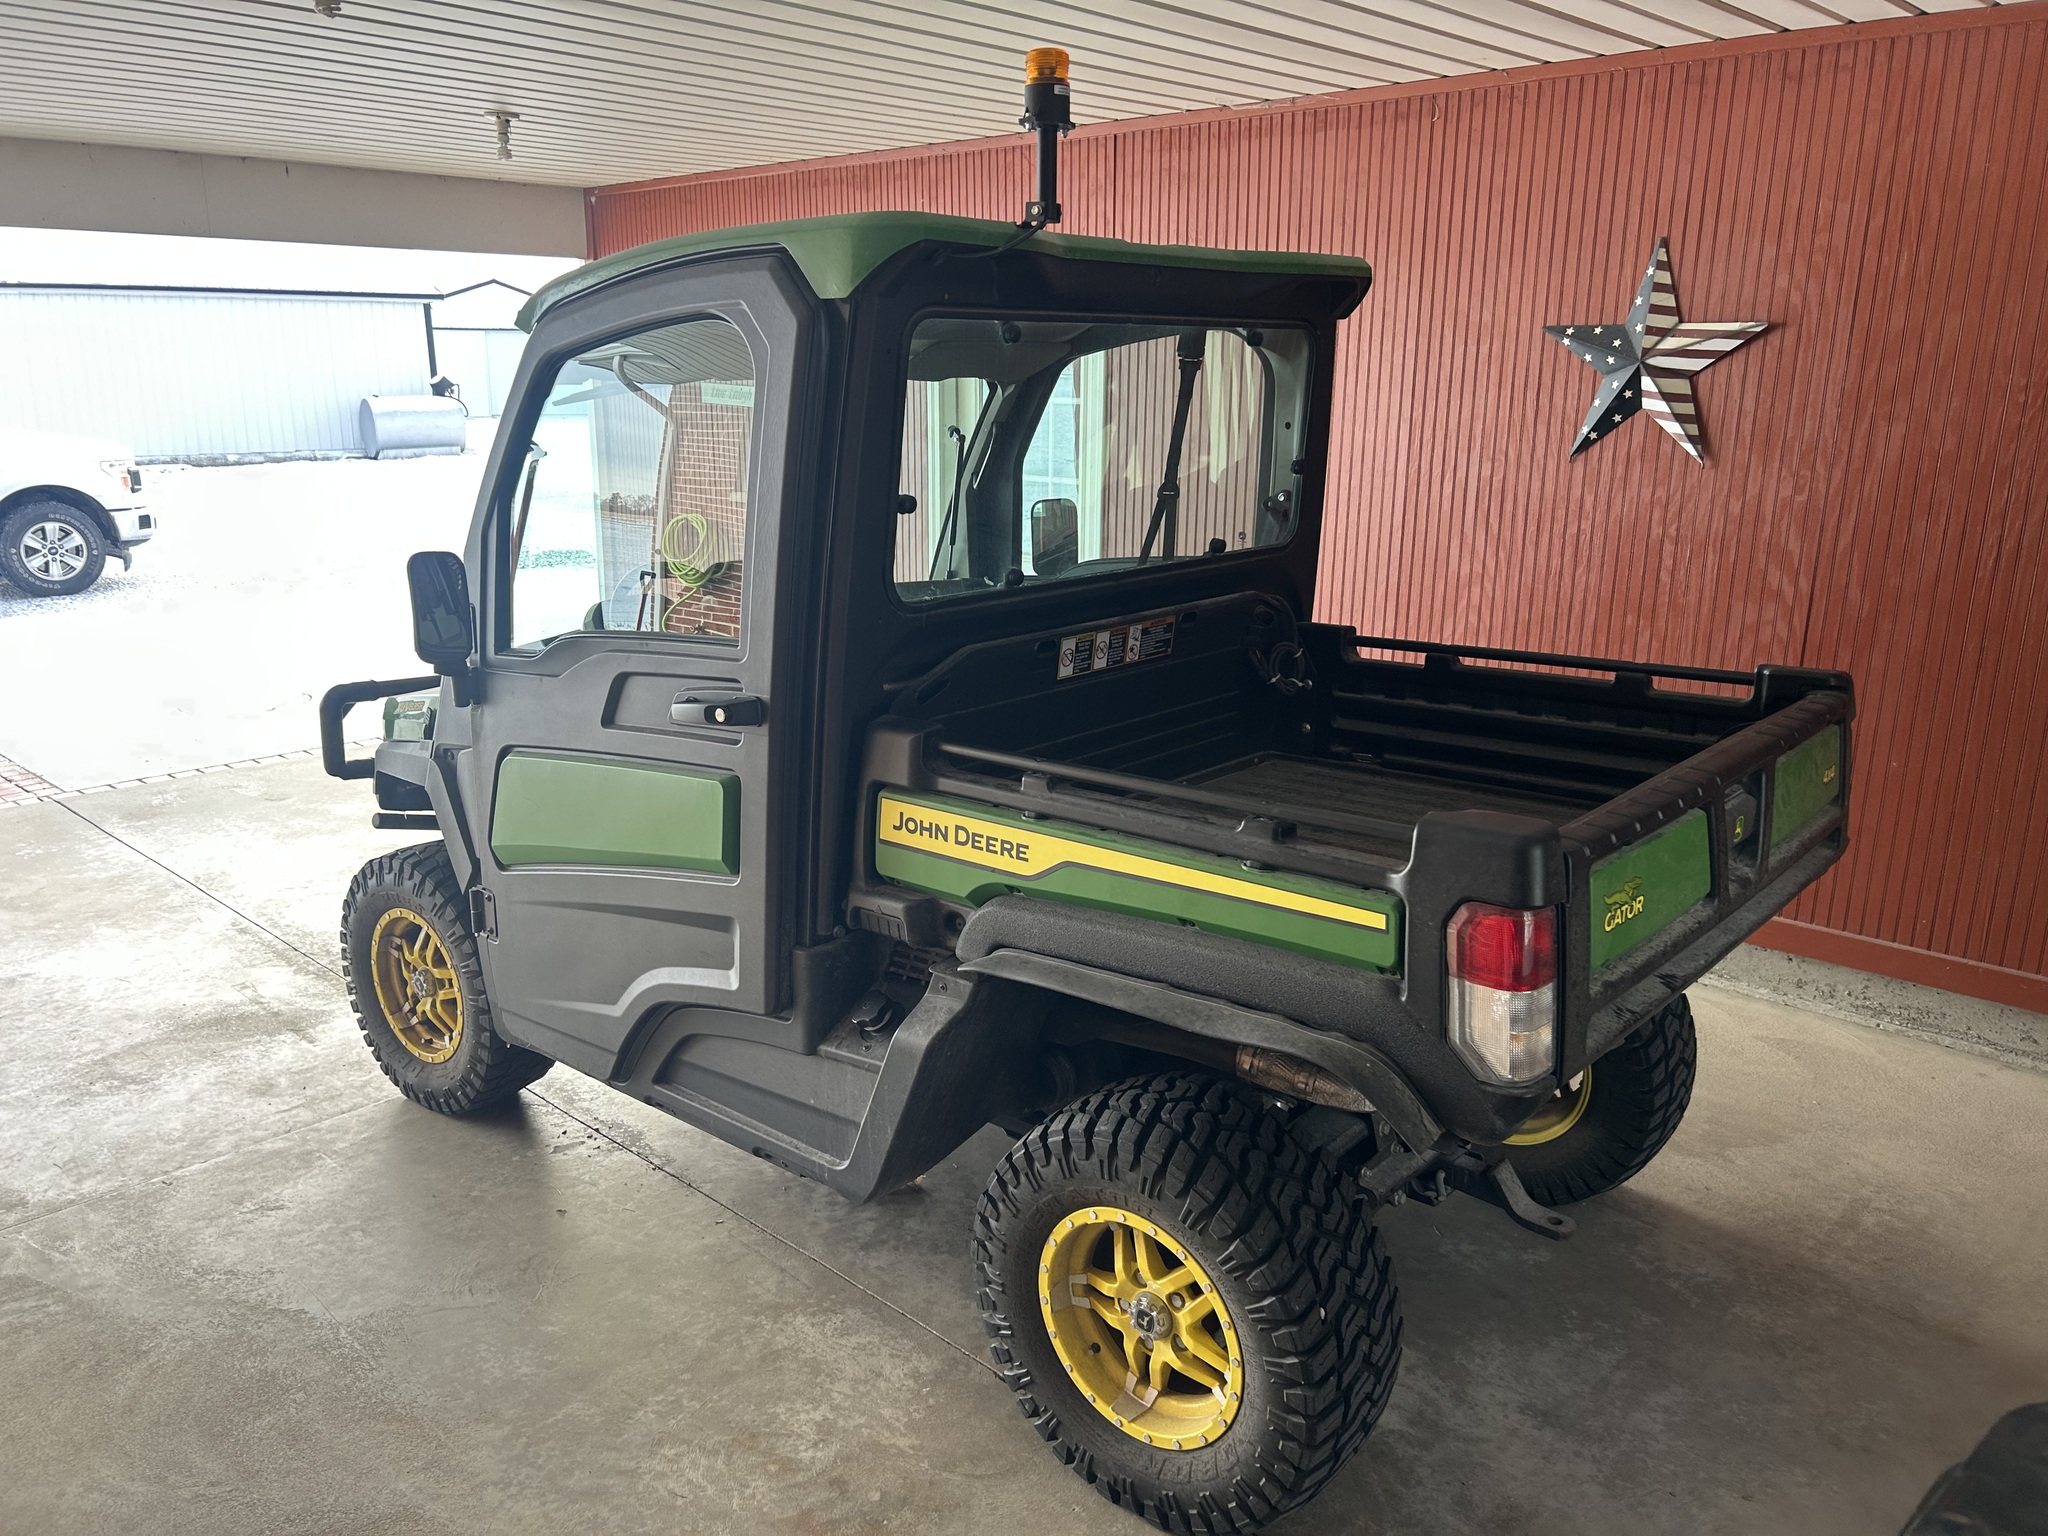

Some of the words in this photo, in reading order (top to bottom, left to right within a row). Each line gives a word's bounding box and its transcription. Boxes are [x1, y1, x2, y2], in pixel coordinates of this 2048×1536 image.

[893, 812, 949, 843] JOHN
[955, 824, 1029, 862] DEERE
[1604, 895, 1644, 932] GATOR
